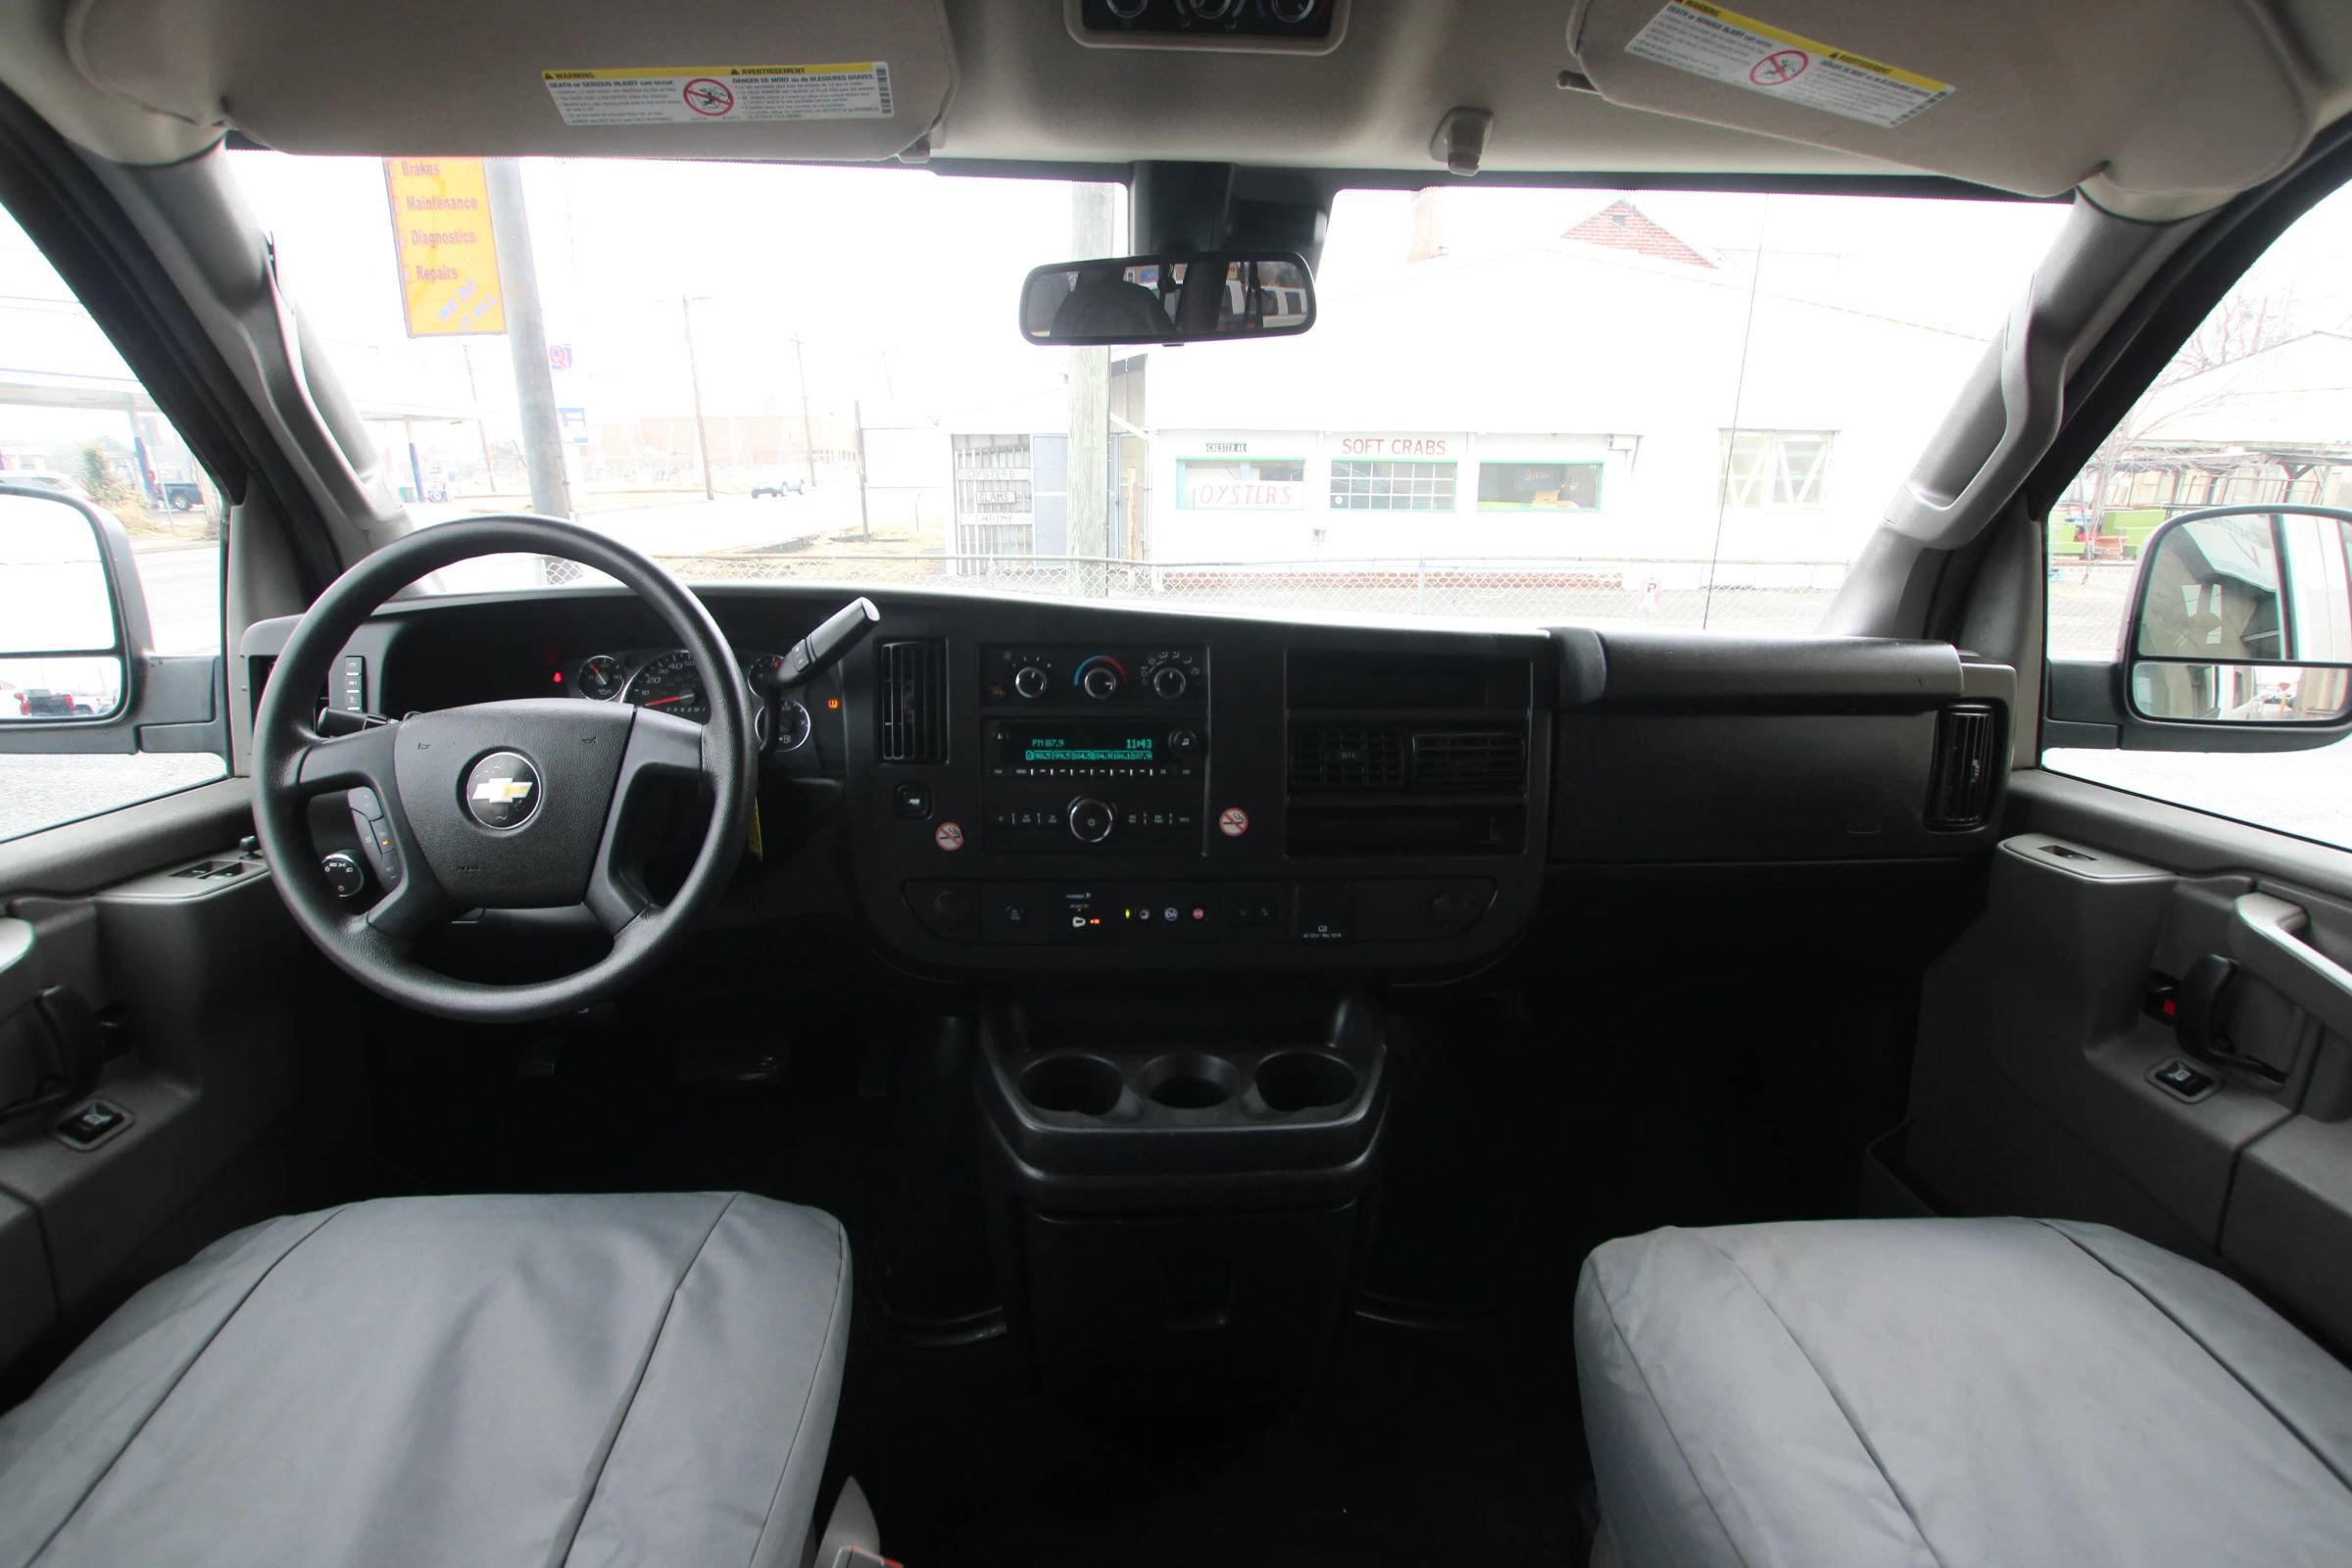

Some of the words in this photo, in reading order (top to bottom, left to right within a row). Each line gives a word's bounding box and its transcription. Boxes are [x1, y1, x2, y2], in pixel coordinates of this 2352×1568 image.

[741, 67, 806, 75] AVERTISSEMENT
[401, 161, 440, 176] Brakes
[407, 195, 478, 211] Maintenance
[411, 228, 477, 247] Diagnostics
[416, 265, 459, 283] Repairs
[1342, 438, 1385, 455] SOFT
[1392, 439, 1446, 455] CRABS
[967, 469, 1015, 479] OYSTERS
[978, 492, 1010, 503] CLAMS
[1200, 484, 1292, 505] OYSTERS
[647, 675, 662, 684] 20
[1126, 739, 1152, 750] 11:43
